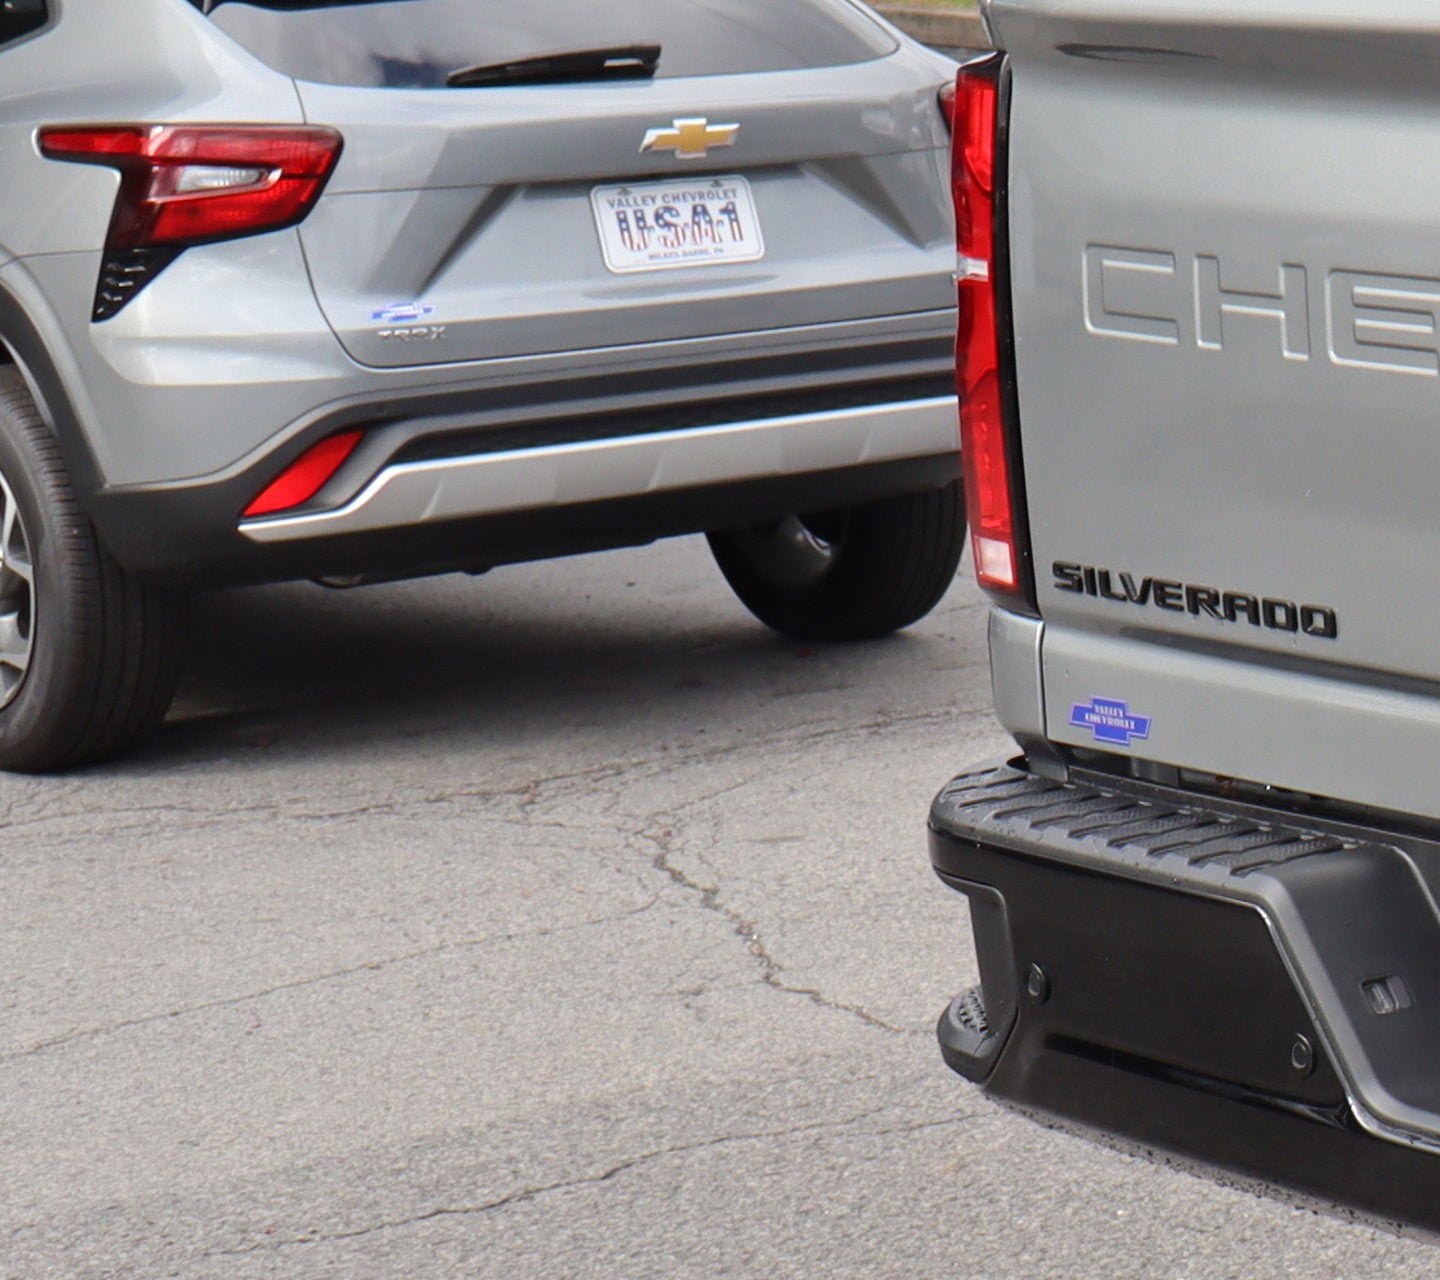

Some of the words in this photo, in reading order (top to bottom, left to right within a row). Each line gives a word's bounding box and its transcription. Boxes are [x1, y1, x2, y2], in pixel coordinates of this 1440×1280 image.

[606, 194, 658, 210] VALLEY
[661, 187, 738, 204] CHEVROLET
[1051, 560, 1339, 639] SILVERADO
[1085, 711, 1136, 730] CHEVROLET
[1093, 704, 1125, 718] VALLEY
